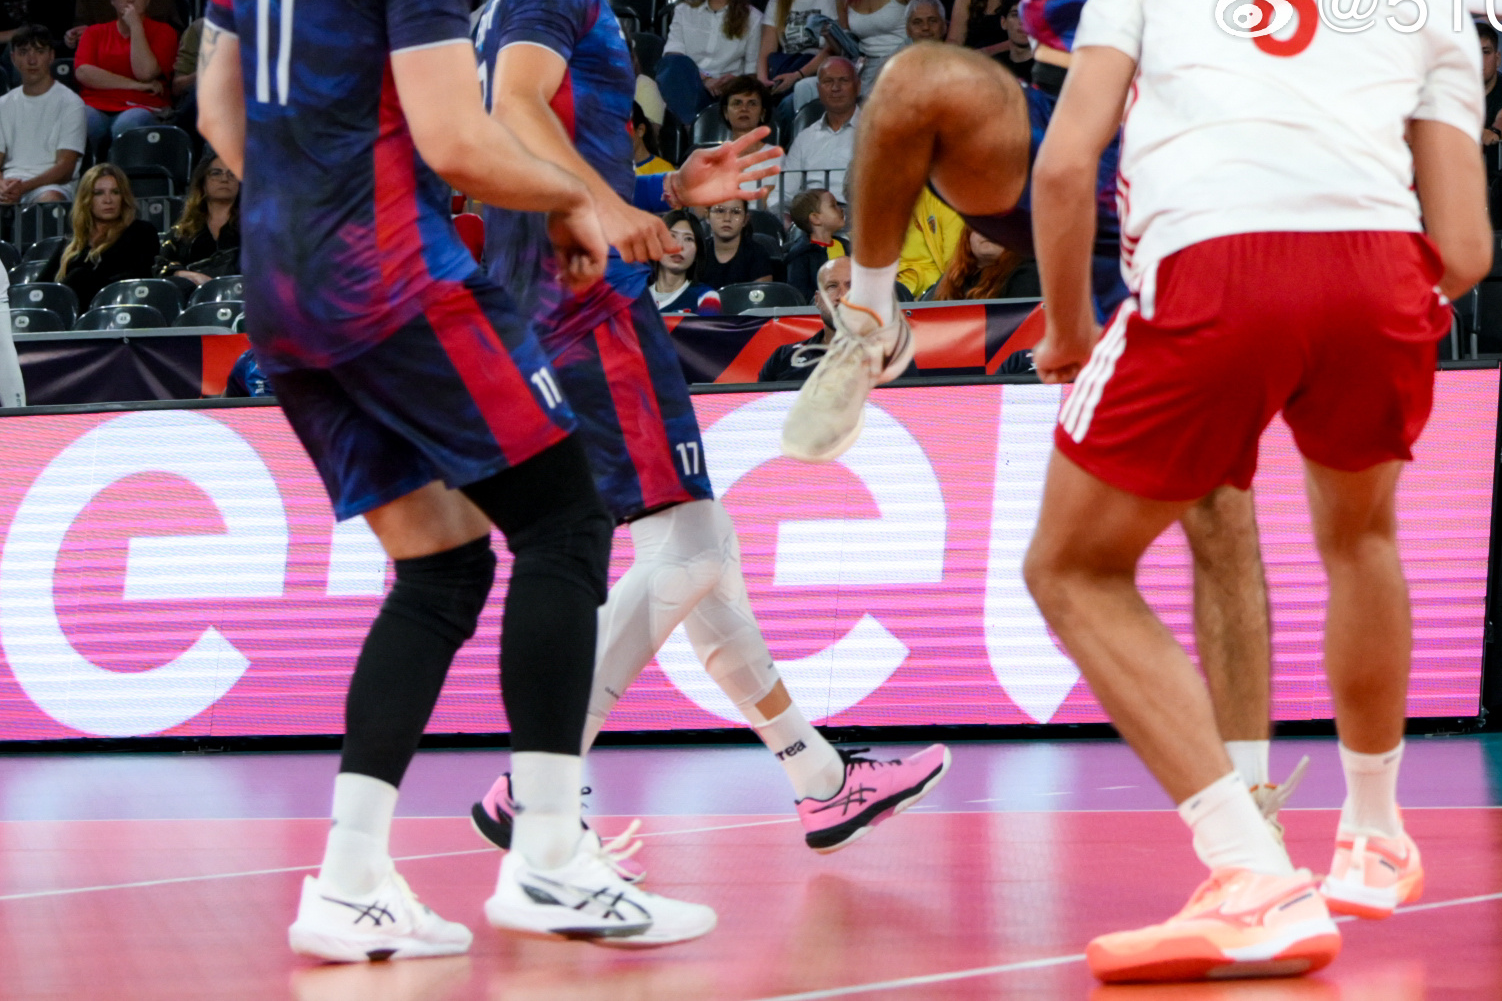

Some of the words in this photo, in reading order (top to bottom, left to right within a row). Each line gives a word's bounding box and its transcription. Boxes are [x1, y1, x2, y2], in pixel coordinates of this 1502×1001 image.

[530, 366, 563, 410] 11
[676, 441, 700, 476] 17
[0, 382, 1082, 739] eel
